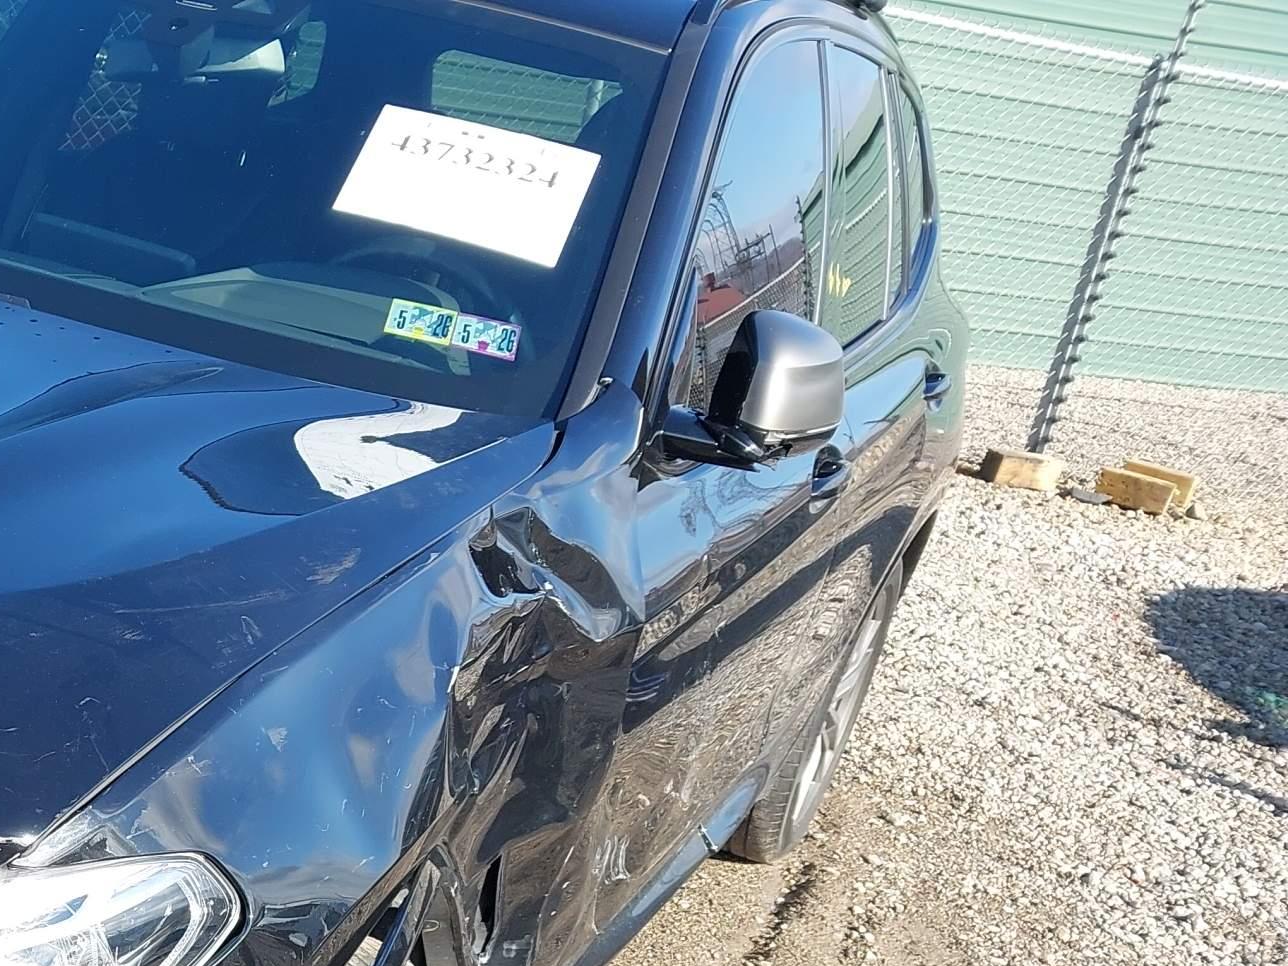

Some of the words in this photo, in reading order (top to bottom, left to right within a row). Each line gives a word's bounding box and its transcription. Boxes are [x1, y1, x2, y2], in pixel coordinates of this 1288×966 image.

[391, 135, 559, 188] 43732324
[396, 309, 409, 330] 5
[432, 313, 453, 339] 26
[460, 323, 473, 344] 5
[496, 327, 517, 353] 26
